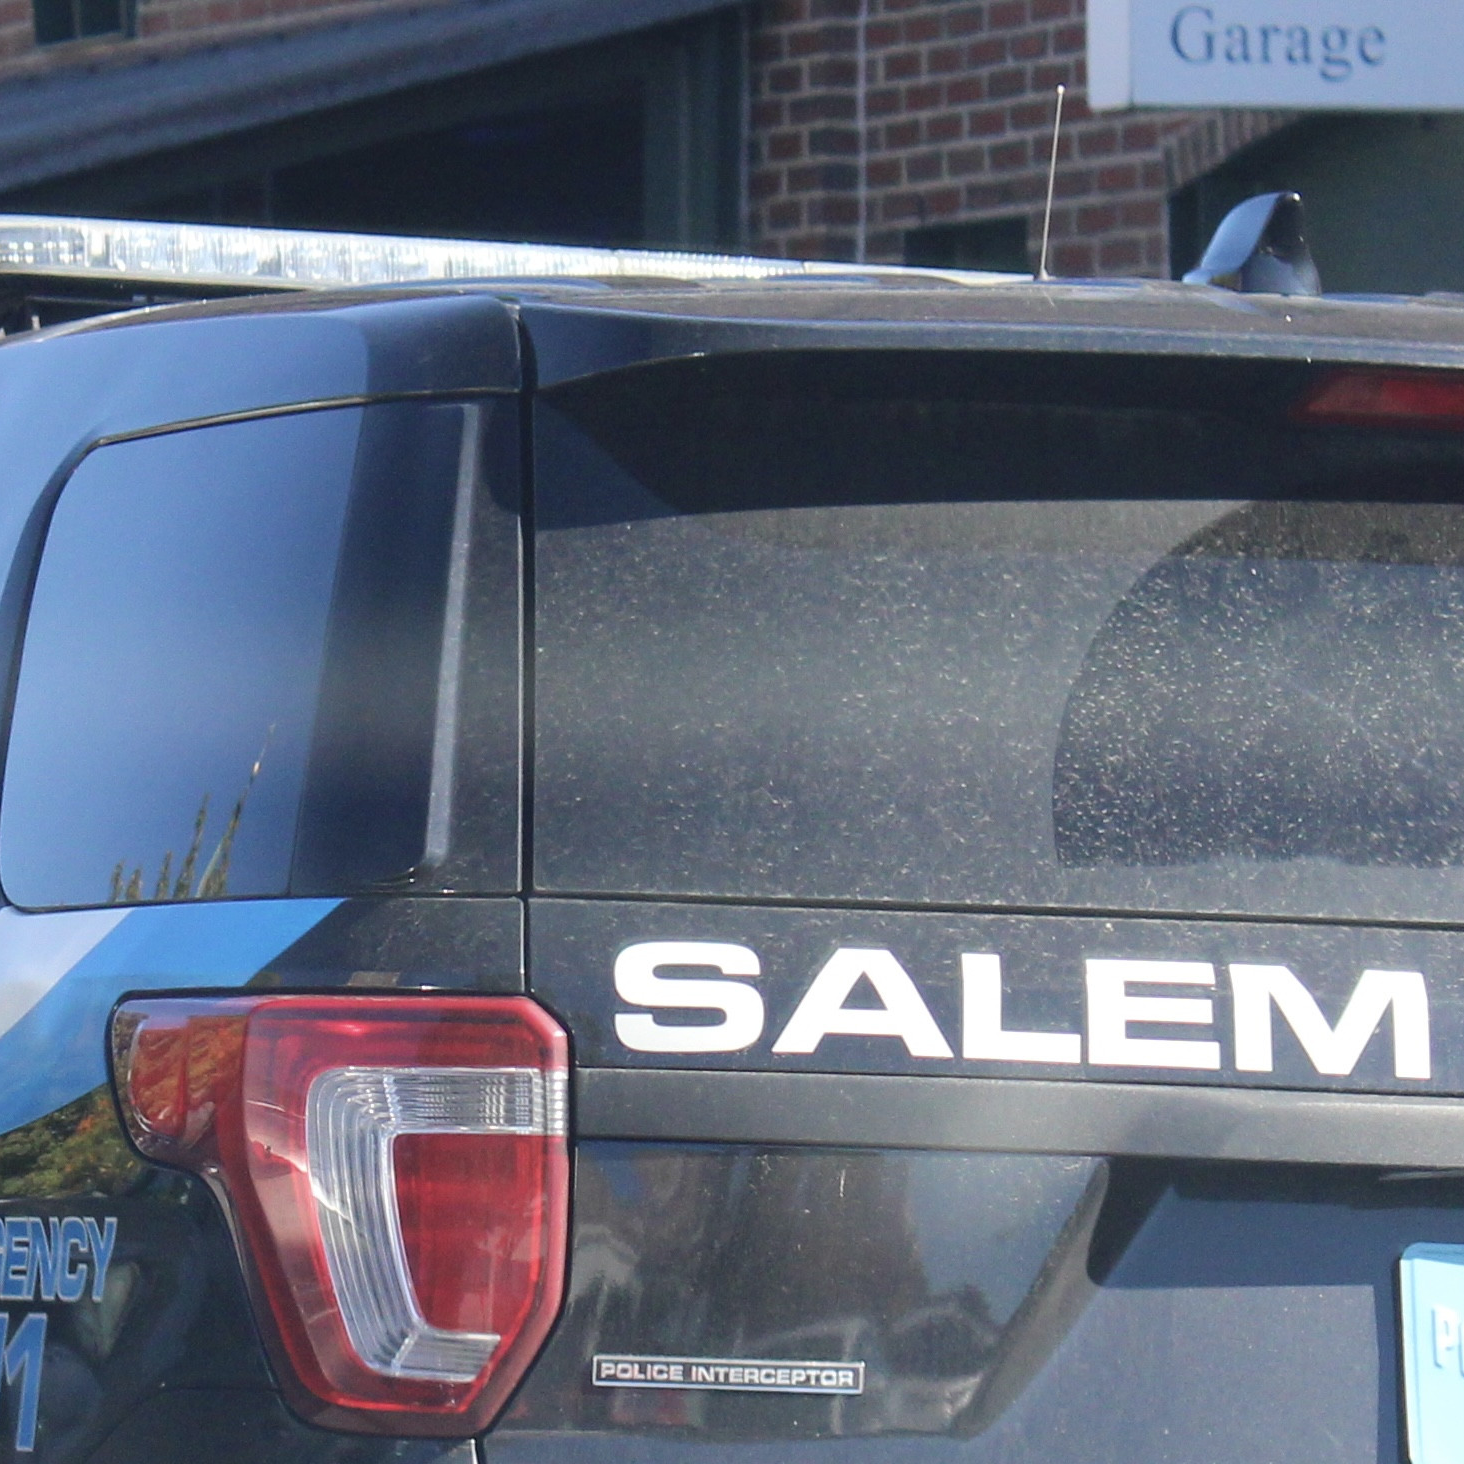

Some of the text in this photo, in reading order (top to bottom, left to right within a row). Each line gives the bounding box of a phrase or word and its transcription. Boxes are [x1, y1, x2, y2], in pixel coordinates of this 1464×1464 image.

[1170, 5, 1386, 83] Garage
[613, 941, 1432, 1080] SALEM
[600, 1362, 854, 1386] POLICE INTERCEPTOR
